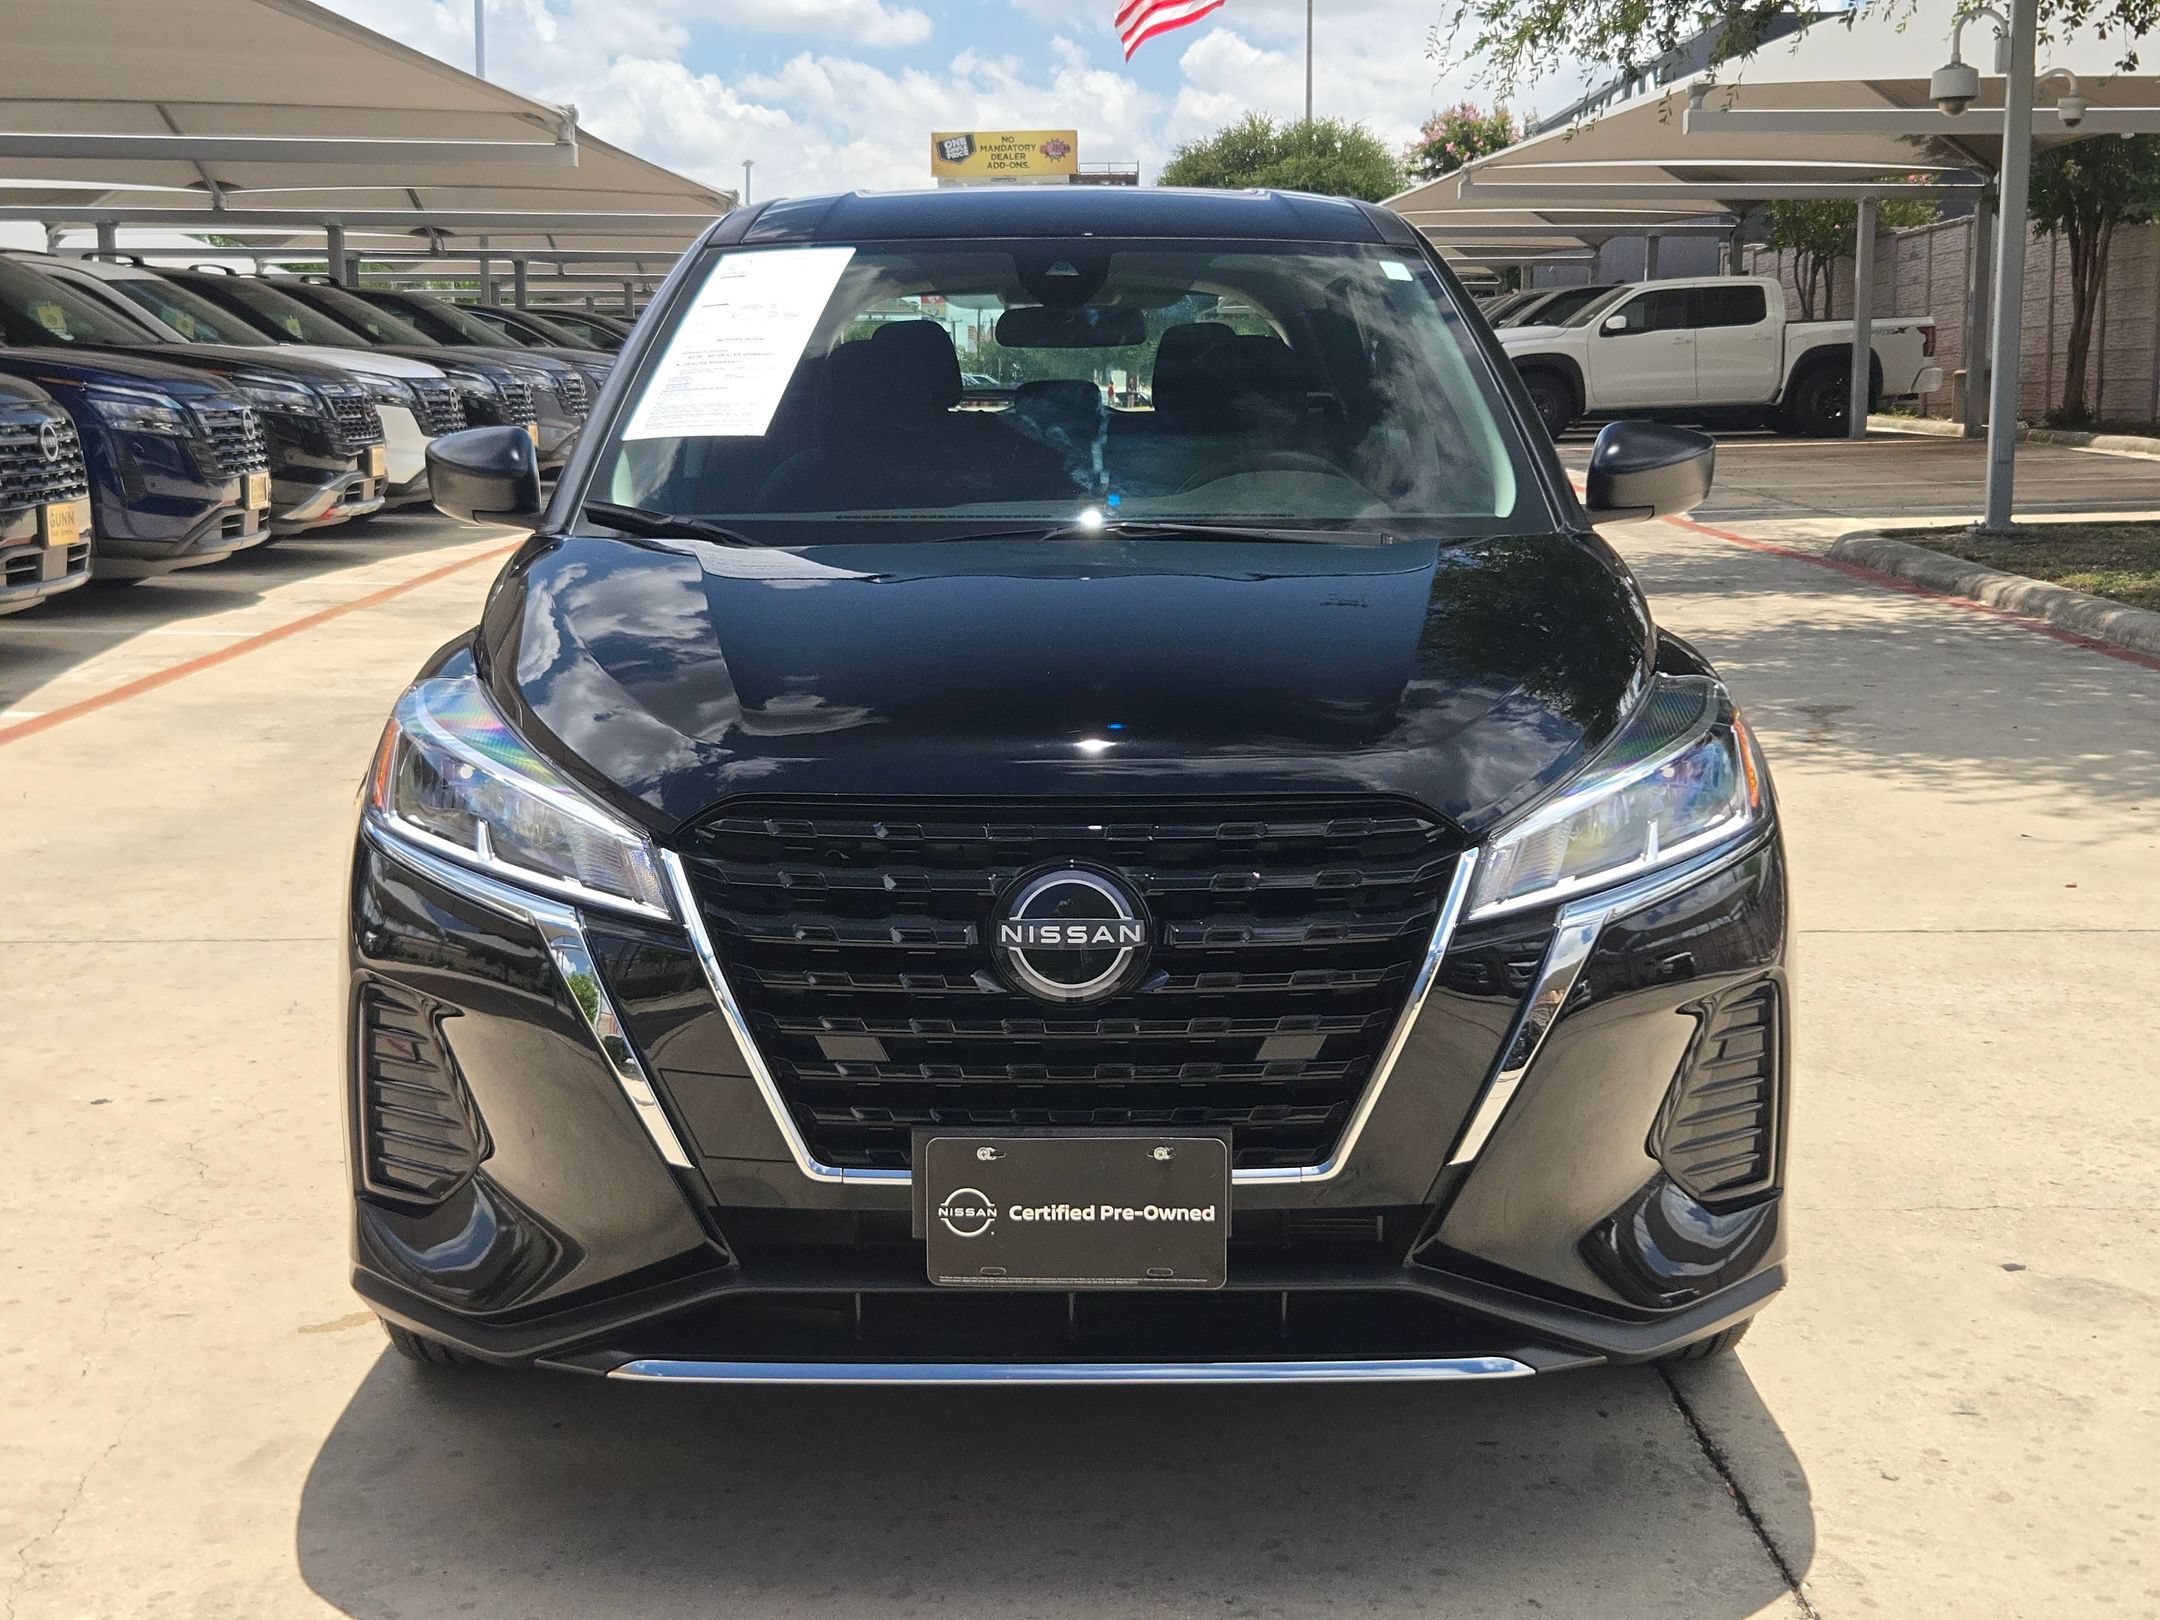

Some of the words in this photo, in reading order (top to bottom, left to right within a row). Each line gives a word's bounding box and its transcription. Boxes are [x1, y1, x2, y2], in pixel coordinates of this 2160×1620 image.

[944, 138, 967, 148] ONE
[1001, 136, 1015, 144] NO
[980, 144, 1036, 152] MANDATORY
[990, 153, 1026, 161] DEALER
[49, 511, 75, 528] GUNN
[1000, 924, 1142, 944] NISSAN
[938, 1206, 997, 1218] NISSAN
[1008, 1204, 1095, 1222] Certified
[1100, 1204, 1216, 1222] Pre-Owned
